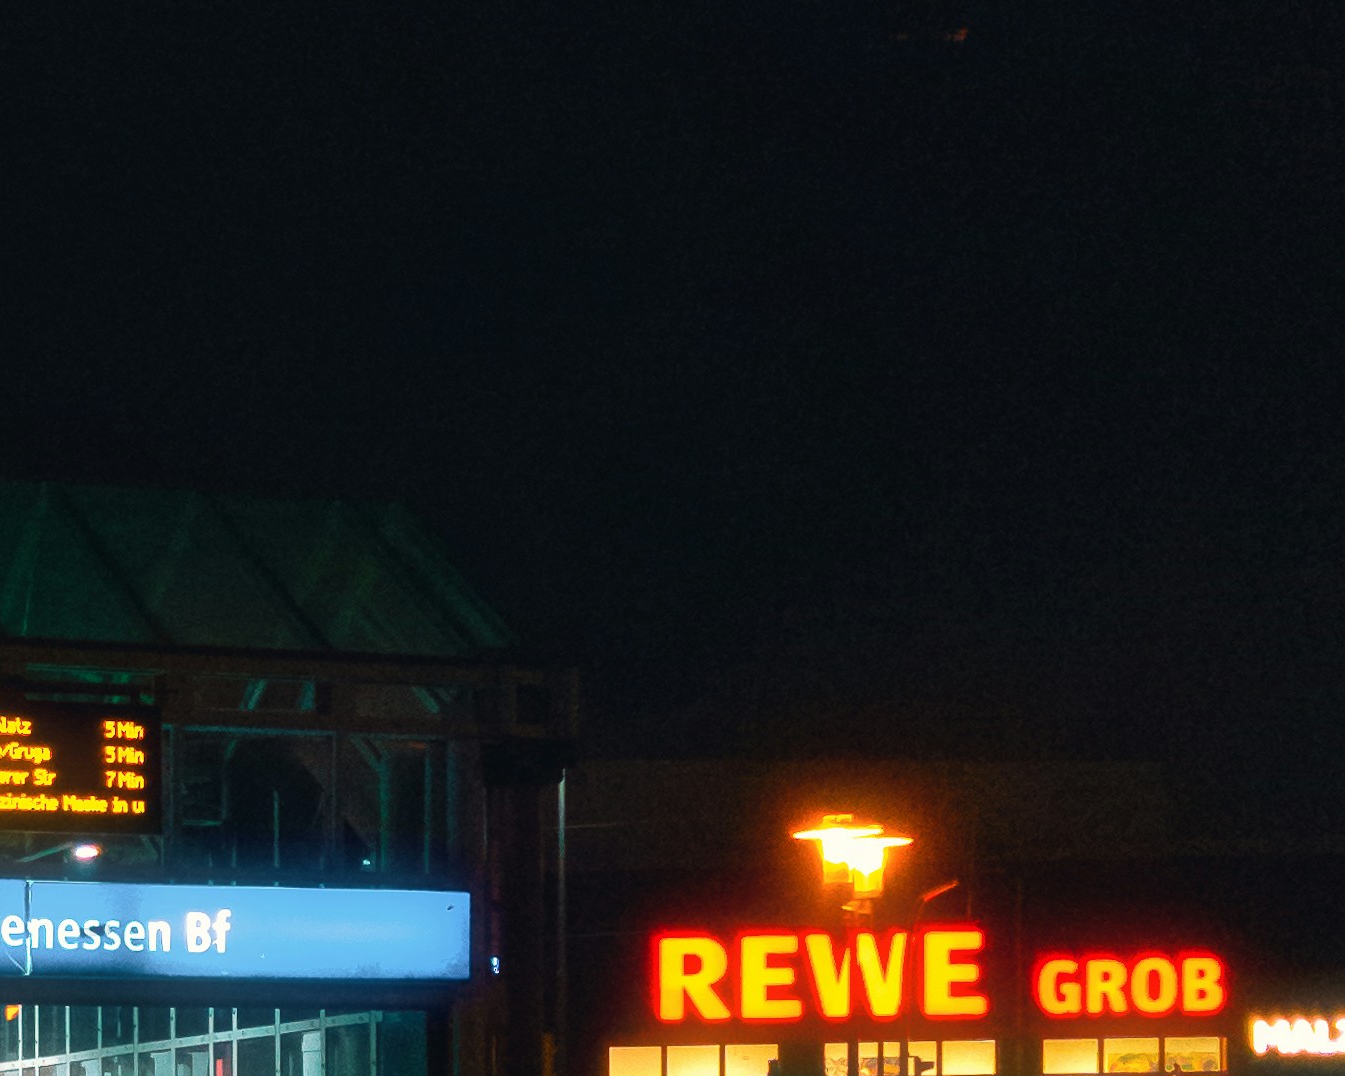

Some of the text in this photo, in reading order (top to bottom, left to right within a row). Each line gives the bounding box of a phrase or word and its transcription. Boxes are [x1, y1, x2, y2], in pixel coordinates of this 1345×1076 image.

[117, 721, 144, 739] Min
[117, 746, 145, 765] Min
[105, 770, 117, 788] 7
[117, 771, 145, 789] Min
[112, 796, 128, 813] in
[185, 908, 231, 953] Bf
[656, 930, 1225, 1022] REWE GROB
